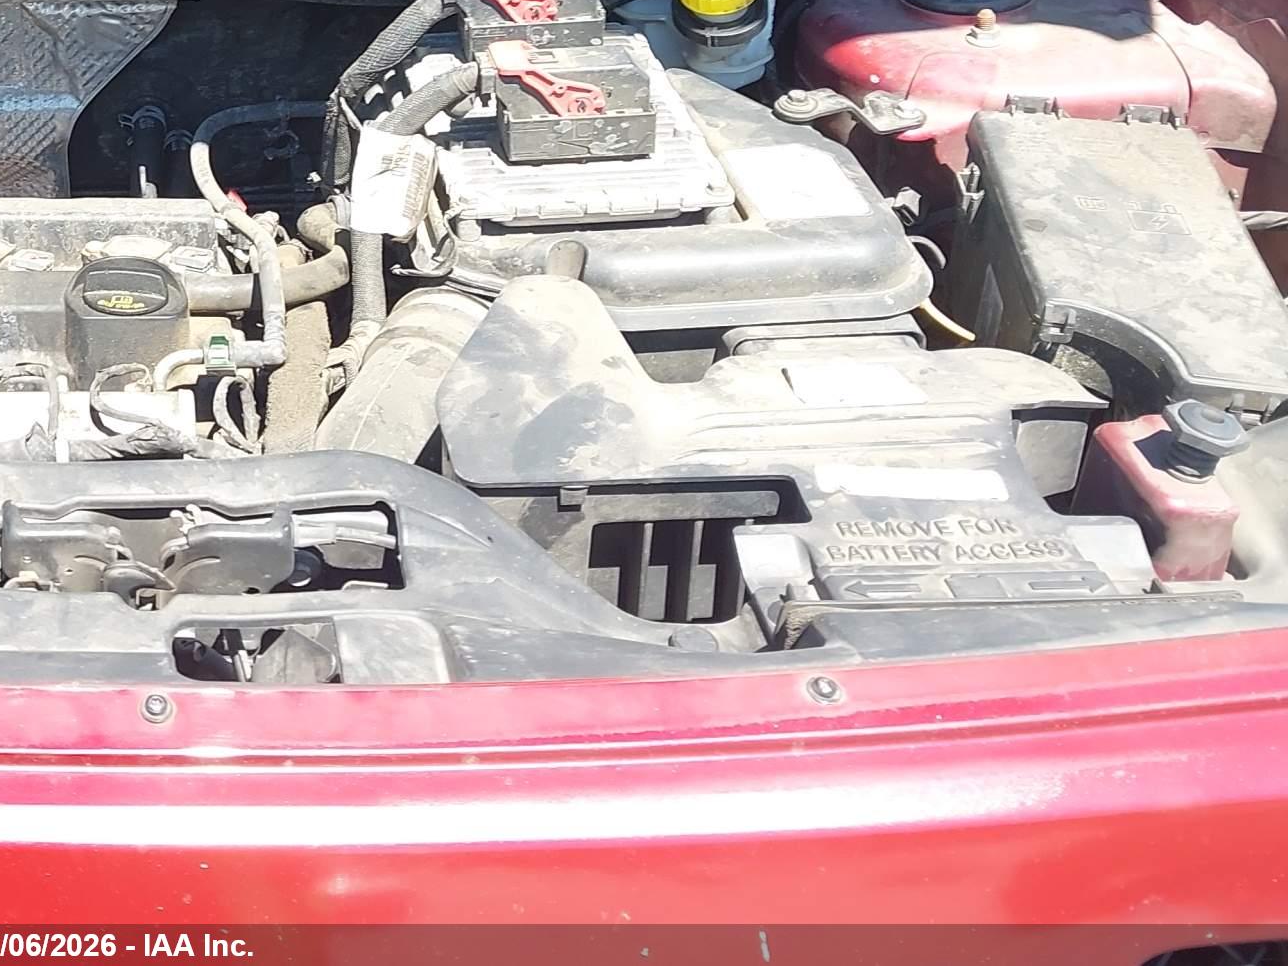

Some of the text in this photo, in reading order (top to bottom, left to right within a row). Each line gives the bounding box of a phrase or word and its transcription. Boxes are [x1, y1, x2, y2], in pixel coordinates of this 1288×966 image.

[834, 517, 1018, 538] REMOVE FOR
[825, 539, 1065, 563] BATTERY ACCESS
